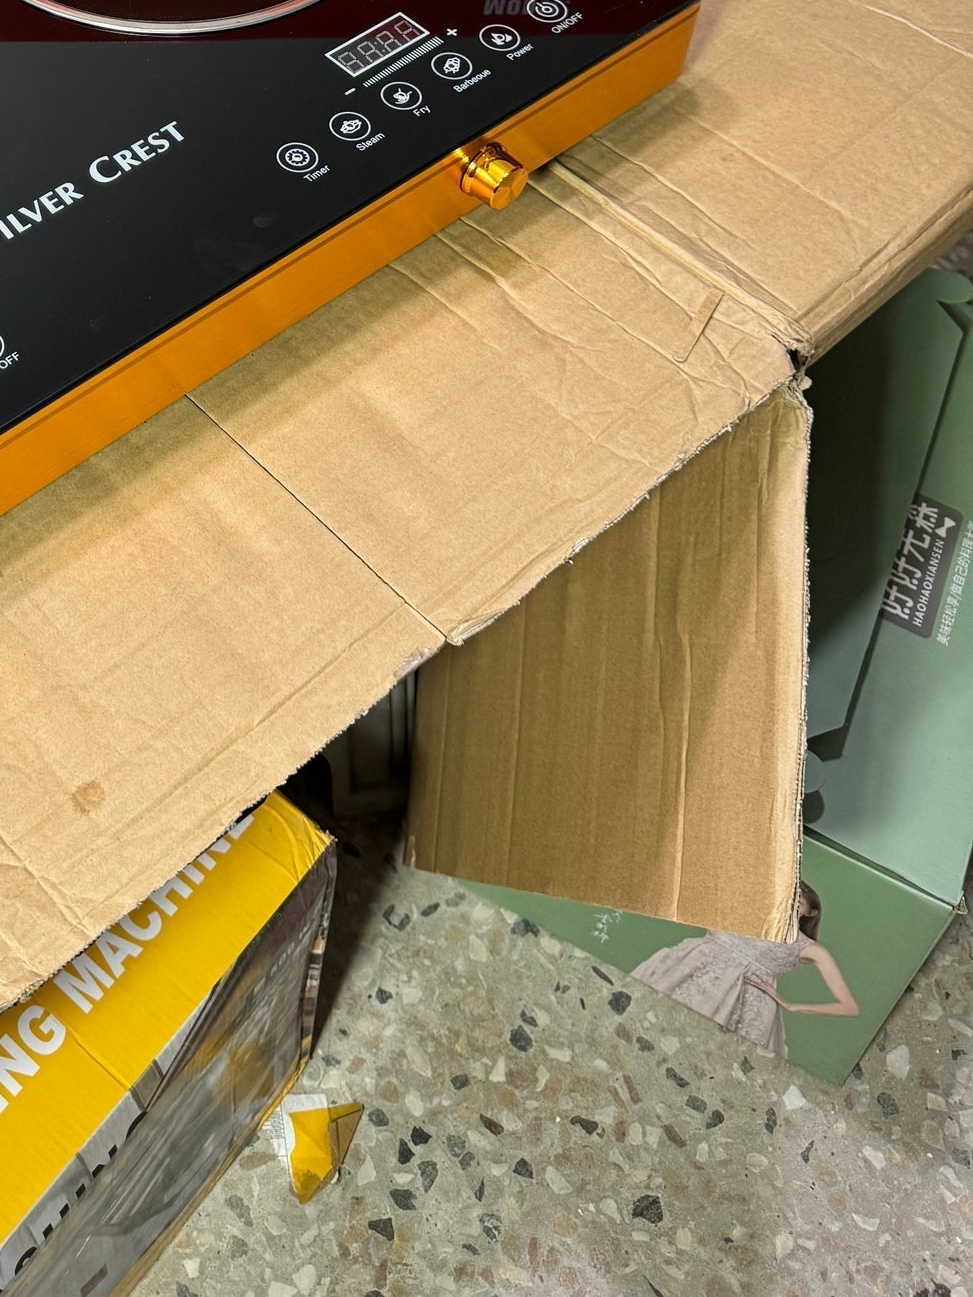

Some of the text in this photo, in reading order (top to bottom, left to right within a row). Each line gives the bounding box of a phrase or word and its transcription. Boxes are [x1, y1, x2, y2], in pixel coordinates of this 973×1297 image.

[551, 10, 584, 35] ON/OFF
[505, 41, 535, 61] Power
[412, 104, 432, 119] Fry
[88, 119, 186, 185] CREST
[354, 130, 386, 153] Steam
[302, 163, 331, 184] Timer
[912, 538, 945, 628] HAOHAOXIANSEN
